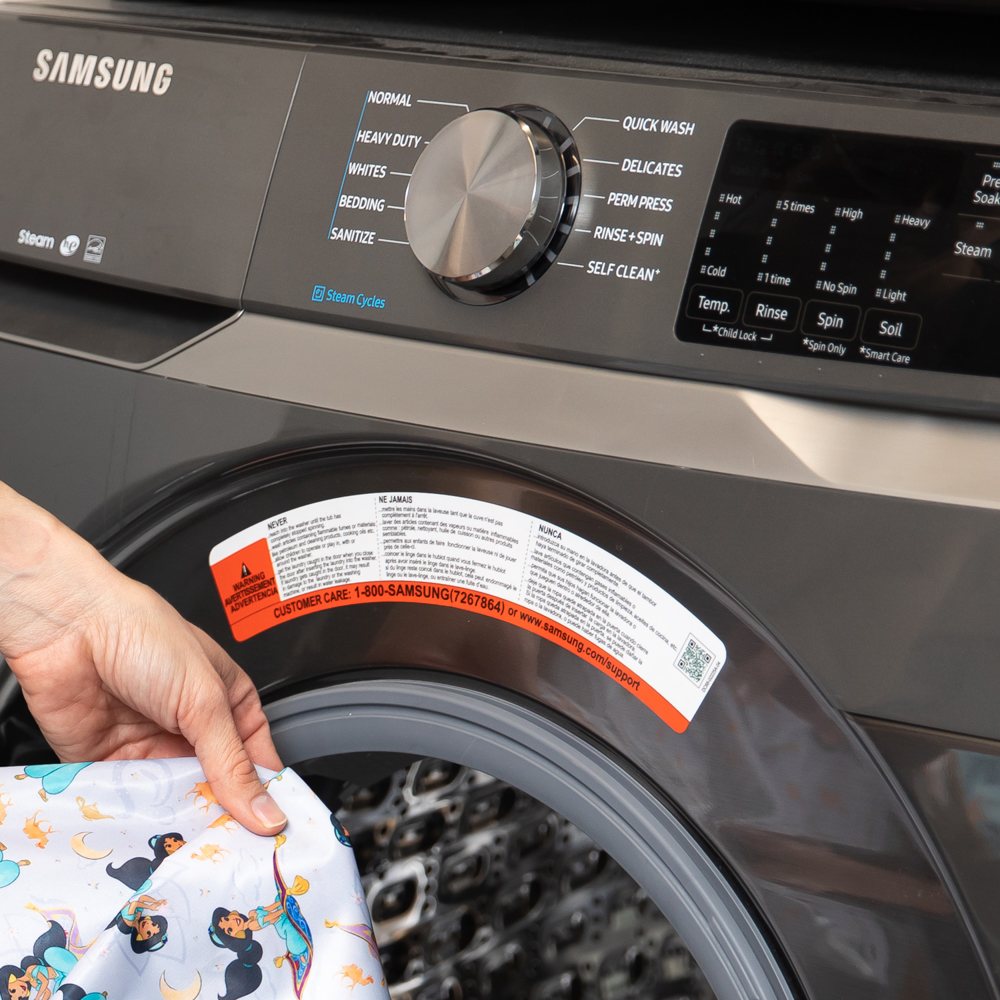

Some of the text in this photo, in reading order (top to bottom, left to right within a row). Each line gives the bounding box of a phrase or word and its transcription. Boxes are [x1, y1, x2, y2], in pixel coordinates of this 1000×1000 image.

[32, 48, 174, 96] SAMSUNG
[367, 90, 412, 107] NORMAL
[622, 116, 696, 136] QUICK WASH
[356, 129, 422, 148] HEAVY DUTY
[348, 162, 387, 179] WHITES
[621, 158, 684, 178] DELICATES
[982, 174, 1000, 188] Pre
[338, 194, 385, 212] BEDDING
[607, 191, 674, 212] PERM PRESS
[725, 193, 742, 205] Hot
[782, 199, 816, 214] 5 times
[841, 207, 864, 221] High
[901, 214, 931, 230] Heavy
[17, 228, 55, 250] Steam
[330, 227, 376, 245] SANITIZE
[953, 241, 992, 258] Steam
[586, 260, 615, 276] SELF
[706, 265, 727, 278] Cold
[764, 272, 791, 286] 1 time
[822, 280, 858, 295] No Spin
[326, 289, 386, 309] Steam Cycles
[882, 288, 907, 302] Light
[698, 295, 731, 315] Temp.
[755, 303, 788, 321] Rinse
[817, 312, 844, 330] Spin
[879, 320, 903, 337] Soil
[739, 331, 757, 342] Lock
[827, 342, 847, 356] Only
[891, 352, 911, 364] Care
[378, 495, 412, 503] NE JAMAIS
[267, 517, 288, 530] NEVER
[538, 524, 562, 540] NUNCA
[233, 571, 266, 591] WARNING
[224, 577, 276, 607] AVERTISSEMENT
[230, 587, 279, 614] ADVERTENCIA
[273, 584, 640, 692] CUSTOMER CARE: 1-800-SAMSUNG(7267864) or www.samsung.com/support
